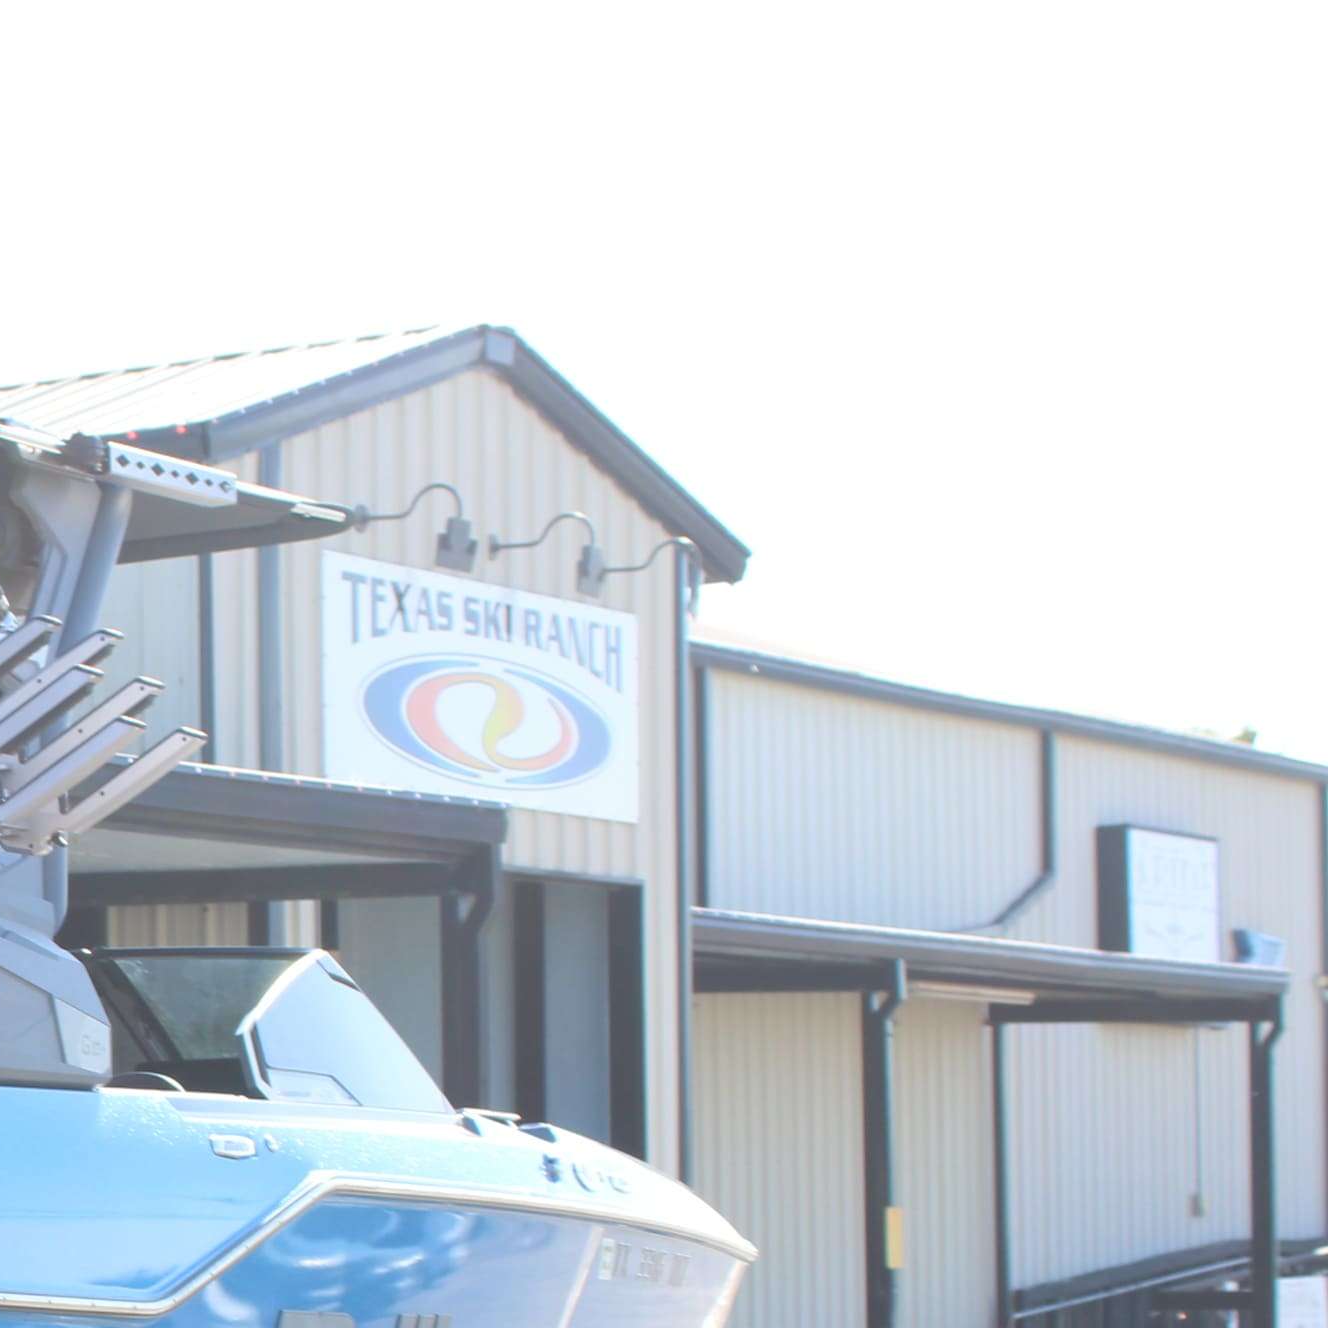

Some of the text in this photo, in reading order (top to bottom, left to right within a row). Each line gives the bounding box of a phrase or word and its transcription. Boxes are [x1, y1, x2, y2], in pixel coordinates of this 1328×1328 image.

[341, 570, 624, 695] TEXAS SKI RANCH
